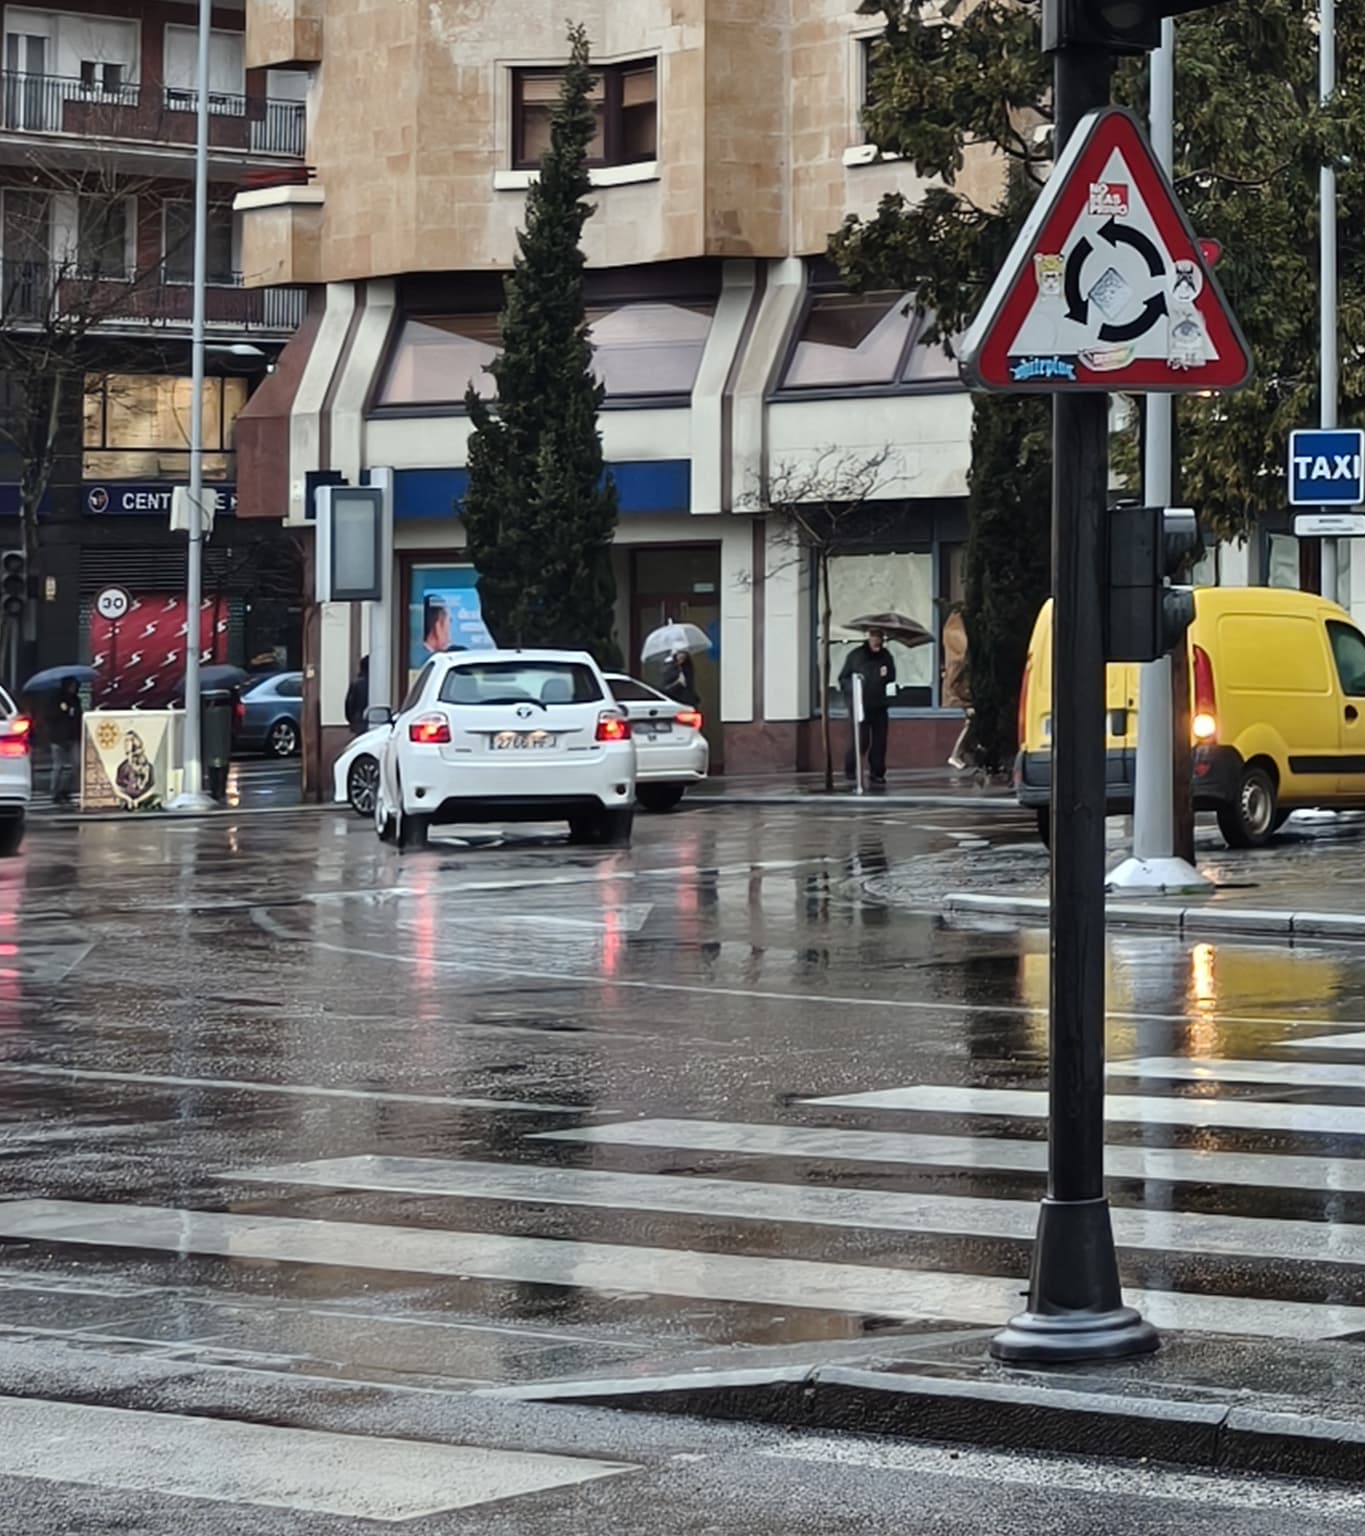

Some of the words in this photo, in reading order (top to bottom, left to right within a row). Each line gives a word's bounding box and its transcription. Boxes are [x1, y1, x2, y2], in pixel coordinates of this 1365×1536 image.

[1294, 454, 1360, 480] TAXI
[122, 492, 172, 510] CENT
[102, 597, 124, 609] 30
